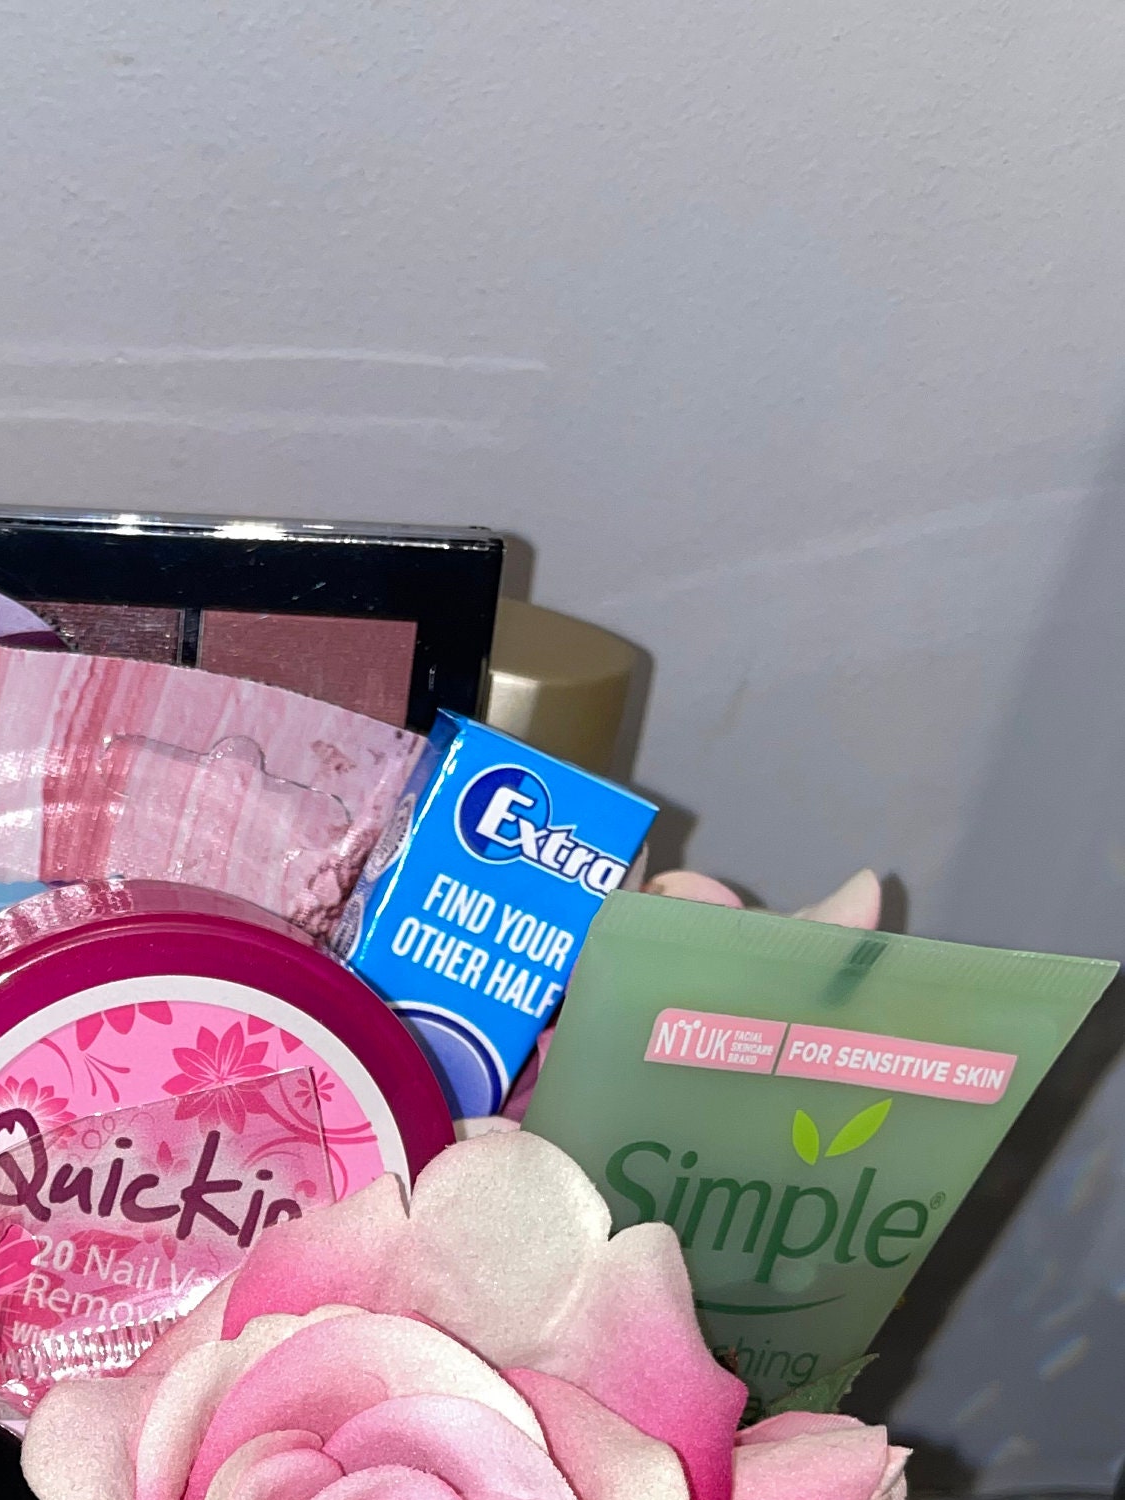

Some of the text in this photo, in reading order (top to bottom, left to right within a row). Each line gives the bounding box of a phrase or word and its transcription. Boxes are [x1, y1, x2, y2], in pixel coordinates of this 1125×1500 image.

[474, 785, 626, 895] Extra
[421, 872, 497, 936] FIND
[492, 903, 575, 973] YOUR
[390, 916, 490, 990] OTHER
[482, 958, 563, 1020] HALF
[726, 1052, 758, 1065] BRAND
[729, 1041, 774, 1056] SKINCARE
[734, 1030, 763, 1044] FACIAL
[788, 1040, 1006, 1091] FOR SENSITIVE SKIN
[605, 1140, 930, 1284] Simple
[29, 1234, 76, 1272] 20
[82, 1244, 160, 1292] Nail
